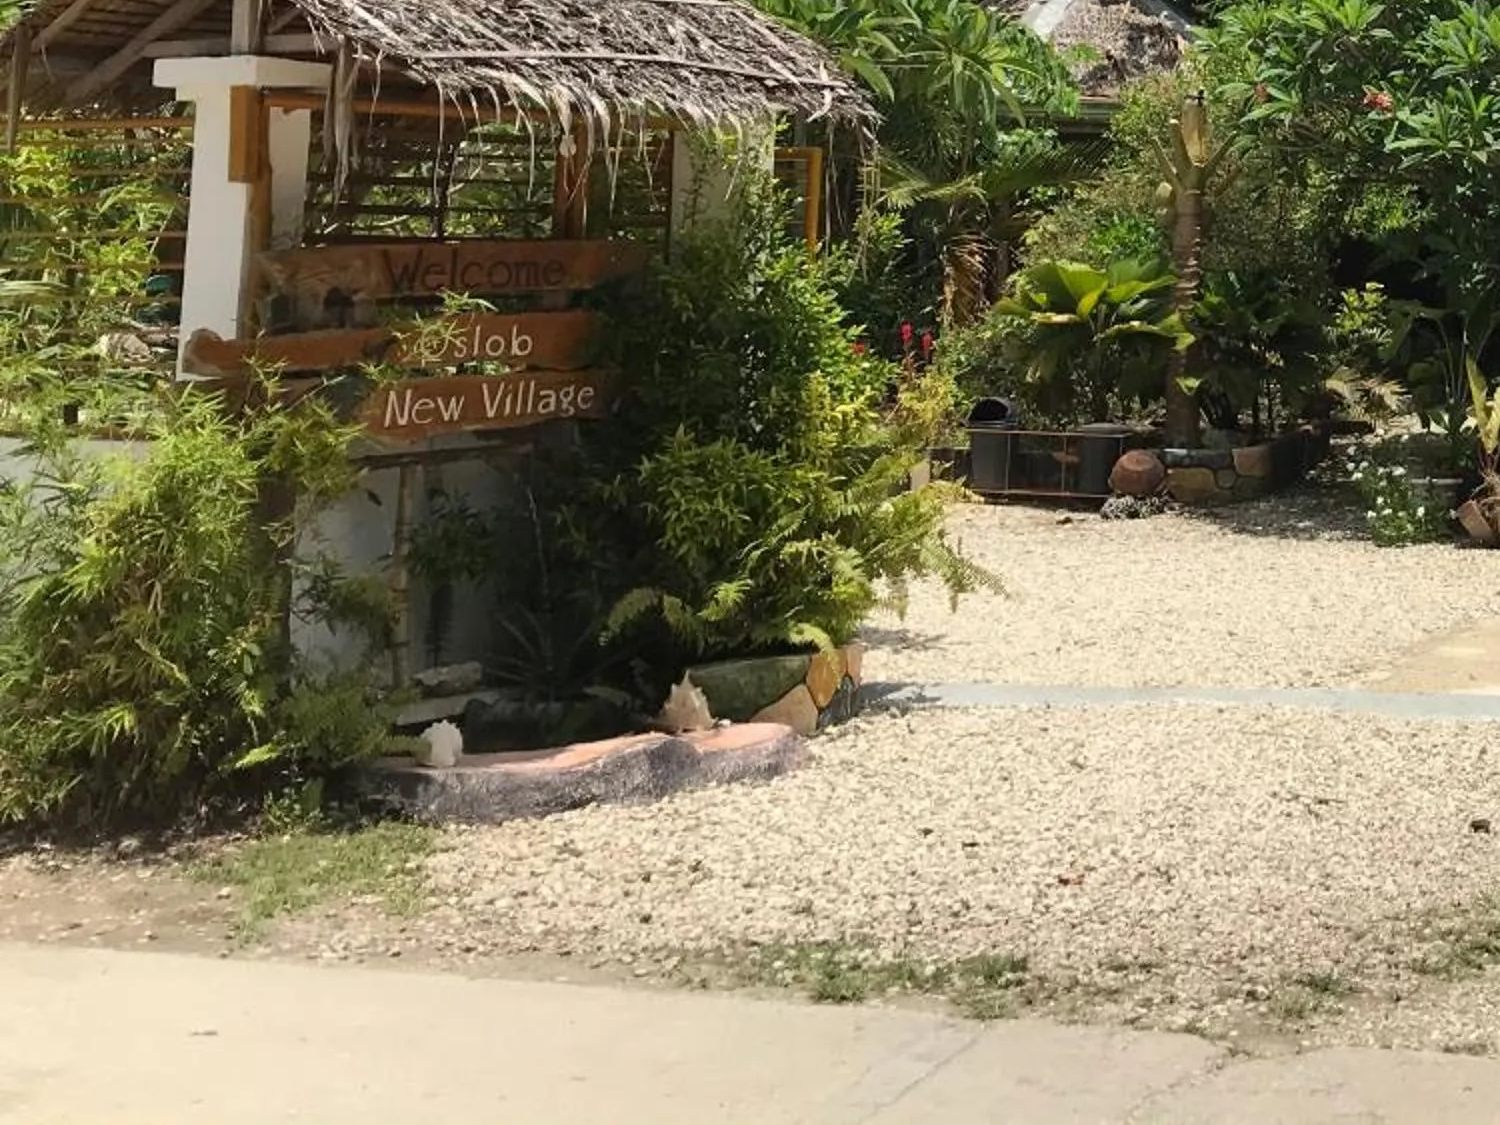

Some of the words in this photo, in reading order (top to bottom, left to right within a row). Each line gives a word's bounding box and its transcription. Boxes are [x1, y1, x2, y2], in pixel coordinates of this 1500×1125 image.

[381, 247, 566, 292] Welcome
[383, 388, 465, 428] New
[481, 379, 595, 417] Village
